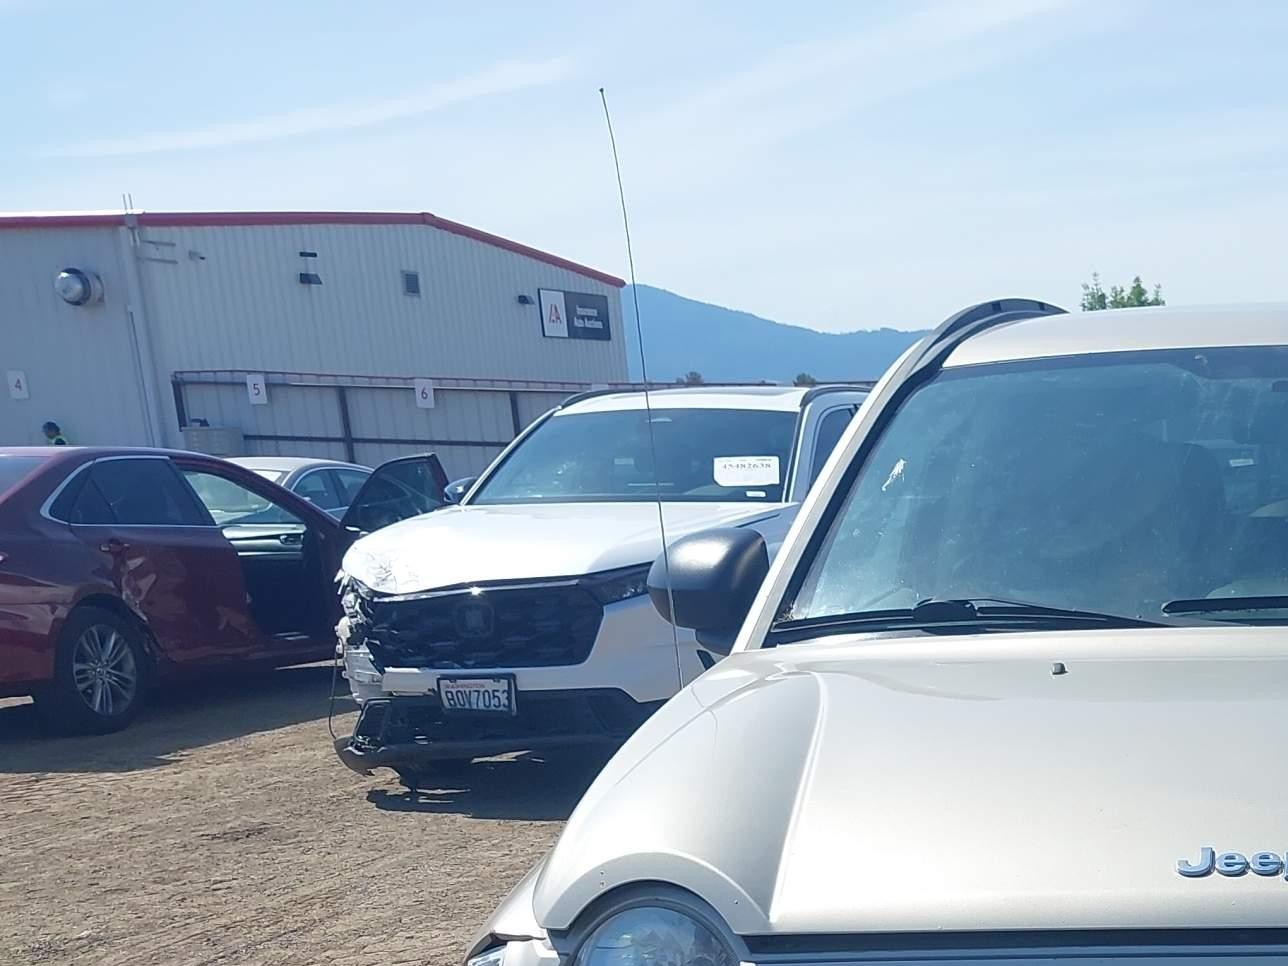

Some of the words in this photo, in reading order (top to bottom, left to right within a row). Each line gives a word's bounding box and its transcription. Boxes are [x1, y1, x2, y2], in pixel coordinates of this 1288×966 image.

[14, 378, 23, 391] 4
[253, 383, 261, 396] 5
[421, 386, 429, 400] 6
